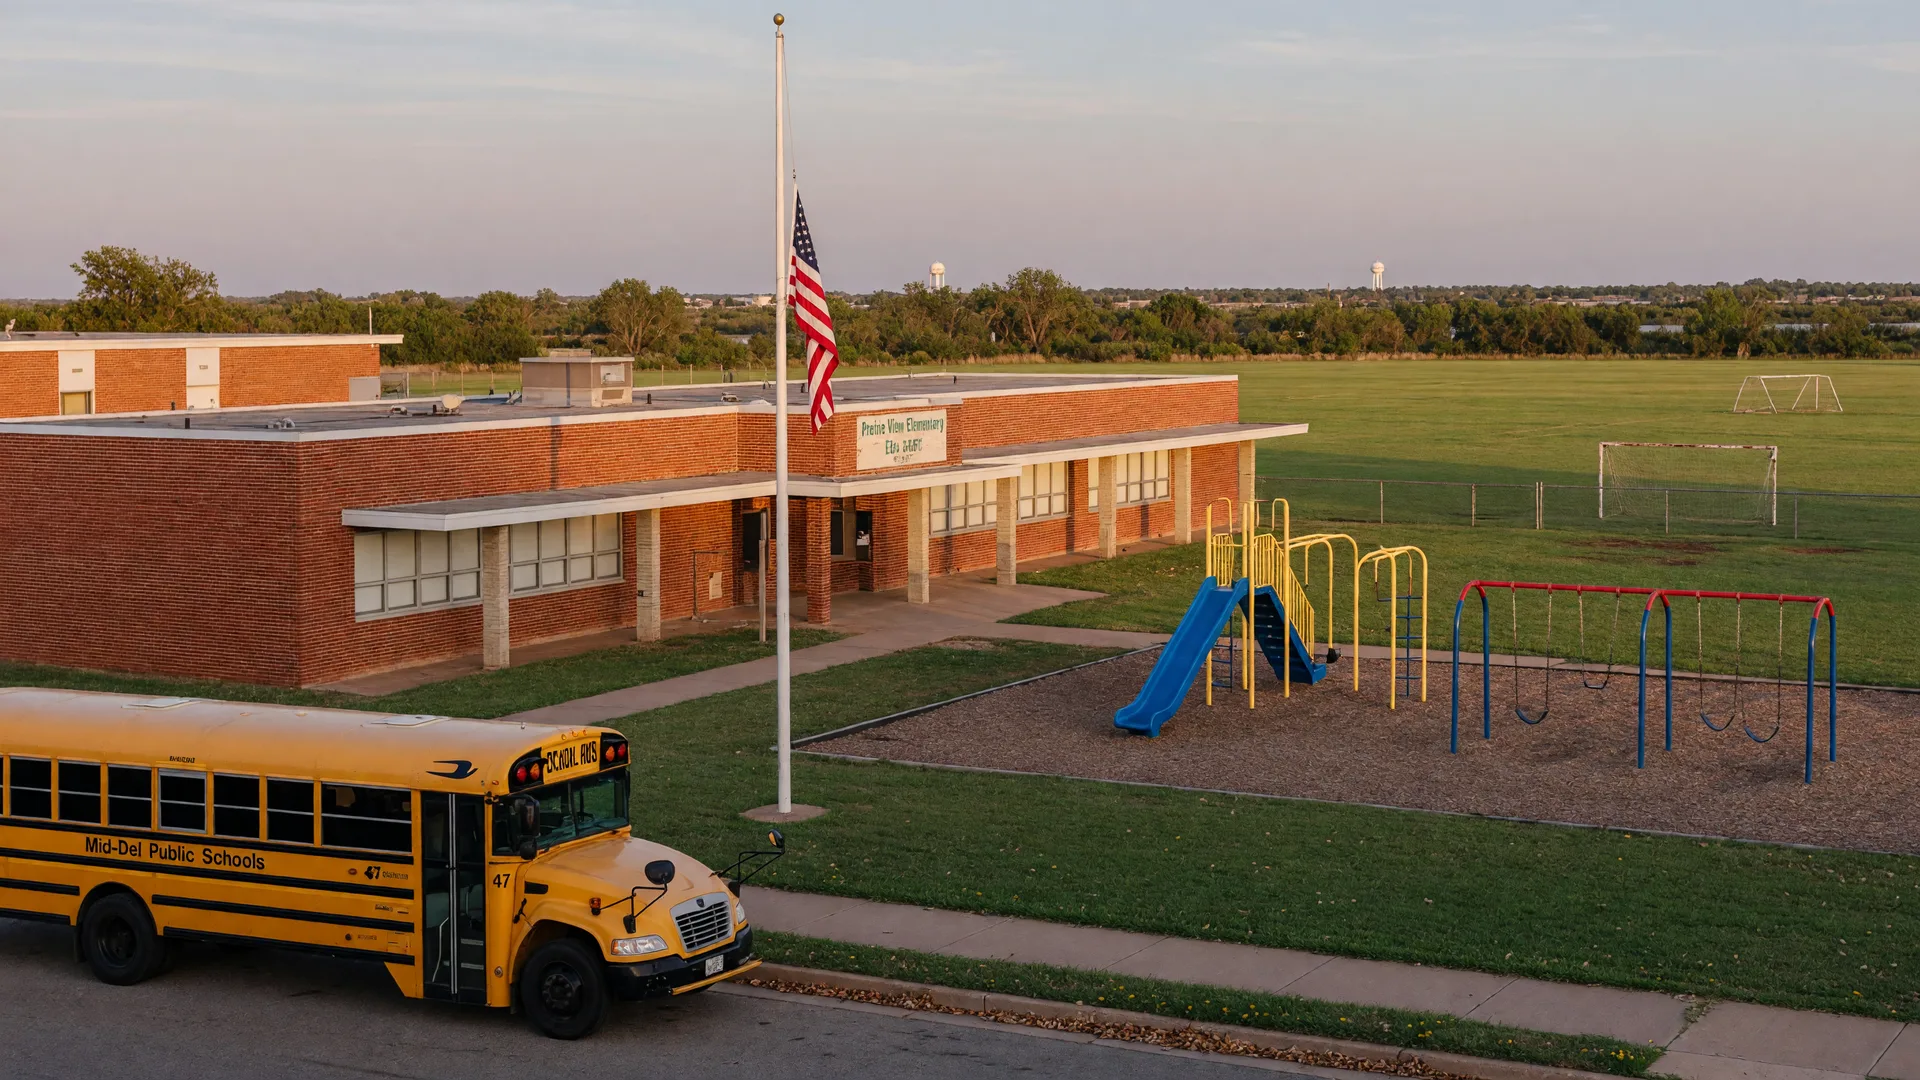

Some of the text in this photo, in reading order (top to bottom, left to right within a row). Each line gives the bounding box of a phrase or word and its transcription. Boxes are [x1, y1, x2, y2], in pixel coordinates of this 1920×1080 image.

[85, 836, 265, 870] Mid-Del Public Schools
[492, 873, 511, 888] 47
